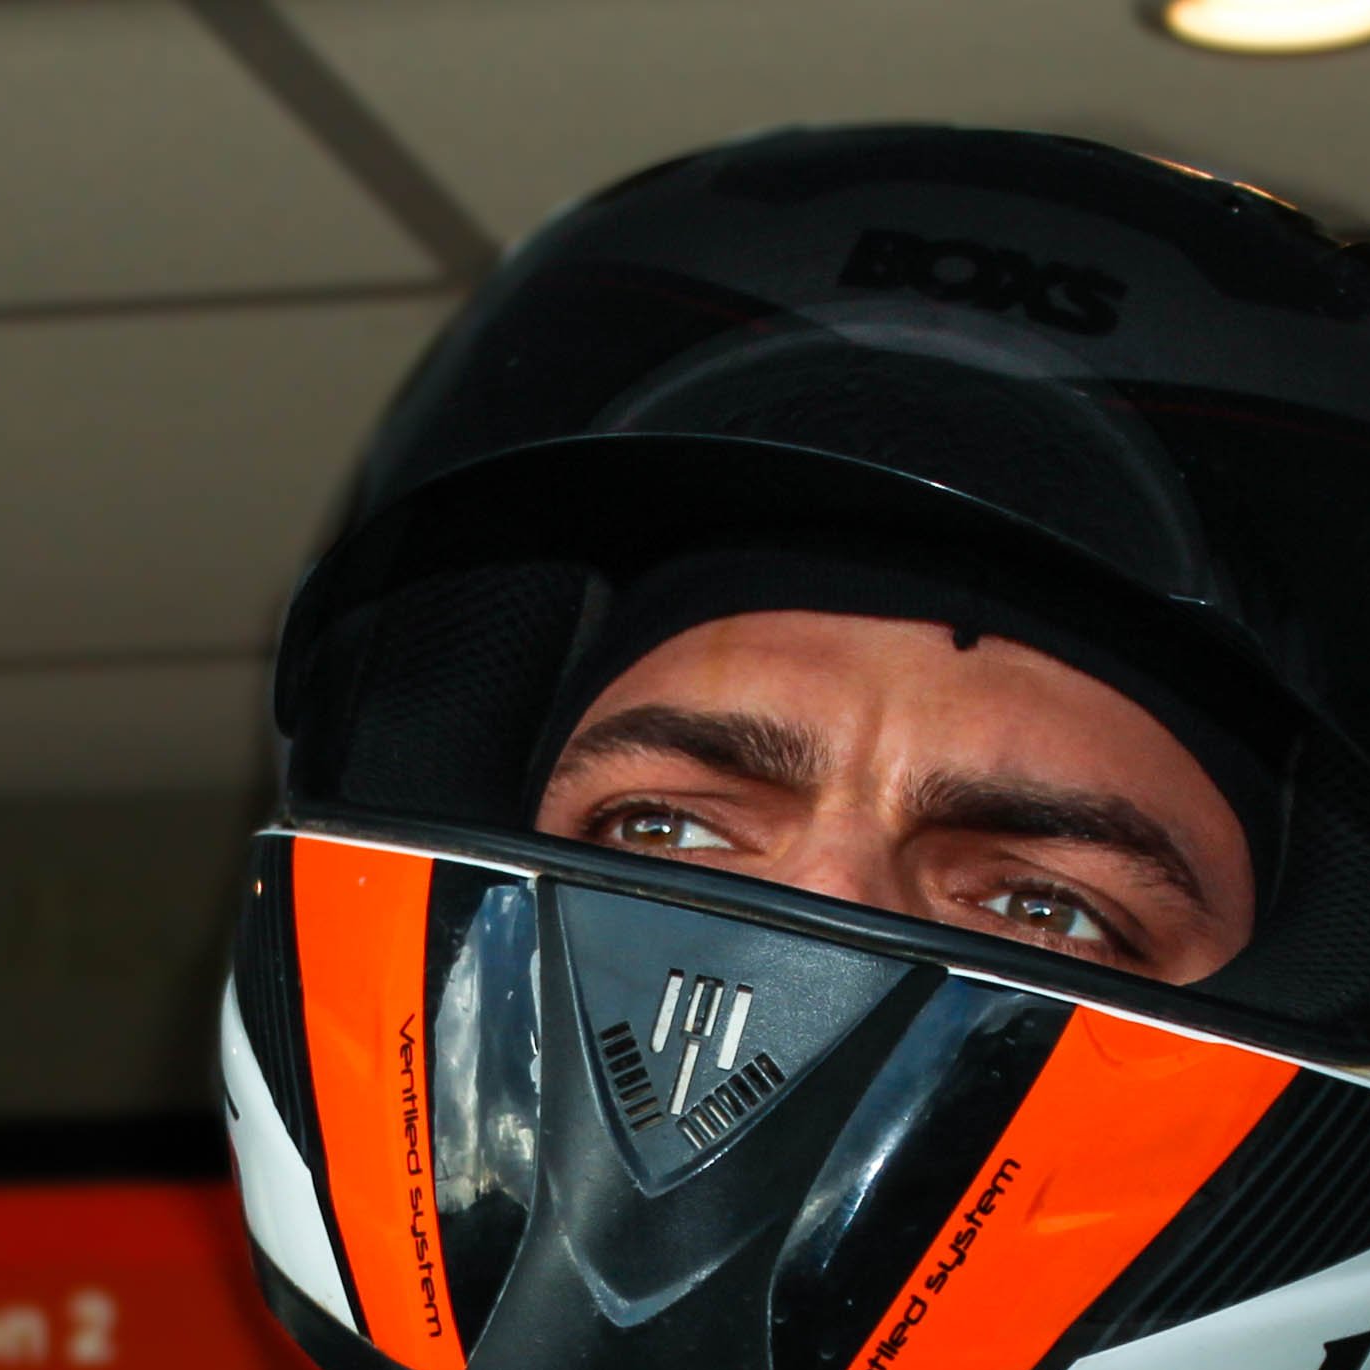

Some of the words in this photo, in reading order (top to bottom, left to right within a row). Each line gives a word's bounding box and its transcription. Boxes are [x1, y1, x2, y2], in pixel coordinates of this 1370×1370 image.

[837, 229, 1128, 336] BOXS
[409, 1186, 443, 1338] system
[925, 1158, 1022, 1294] system
[65, 1290, 117, 1368] 2
